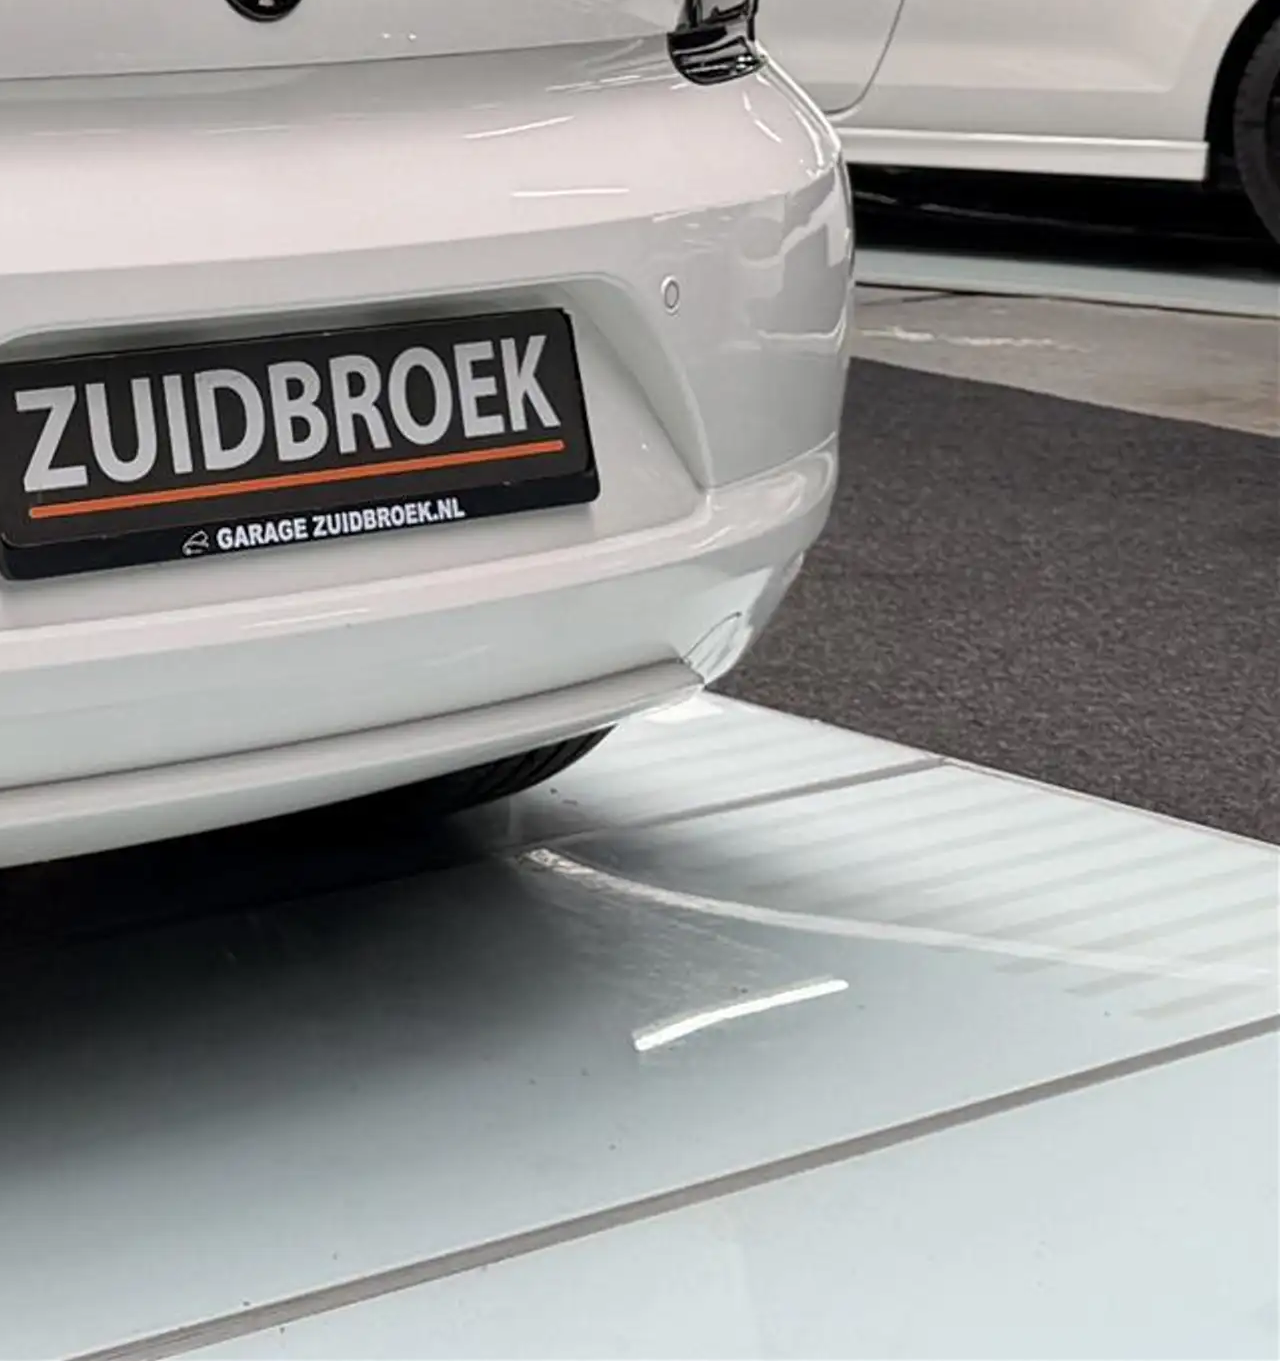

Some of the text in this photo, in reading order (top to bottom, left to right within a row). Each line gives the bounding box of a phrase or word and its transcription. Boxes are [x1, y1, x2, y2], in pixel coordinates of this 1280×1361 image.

[14, 335, 562, 493] ZUIDBROEK
[216, 497, 465, 551] GARAGE ZUIDBROEK.NL
